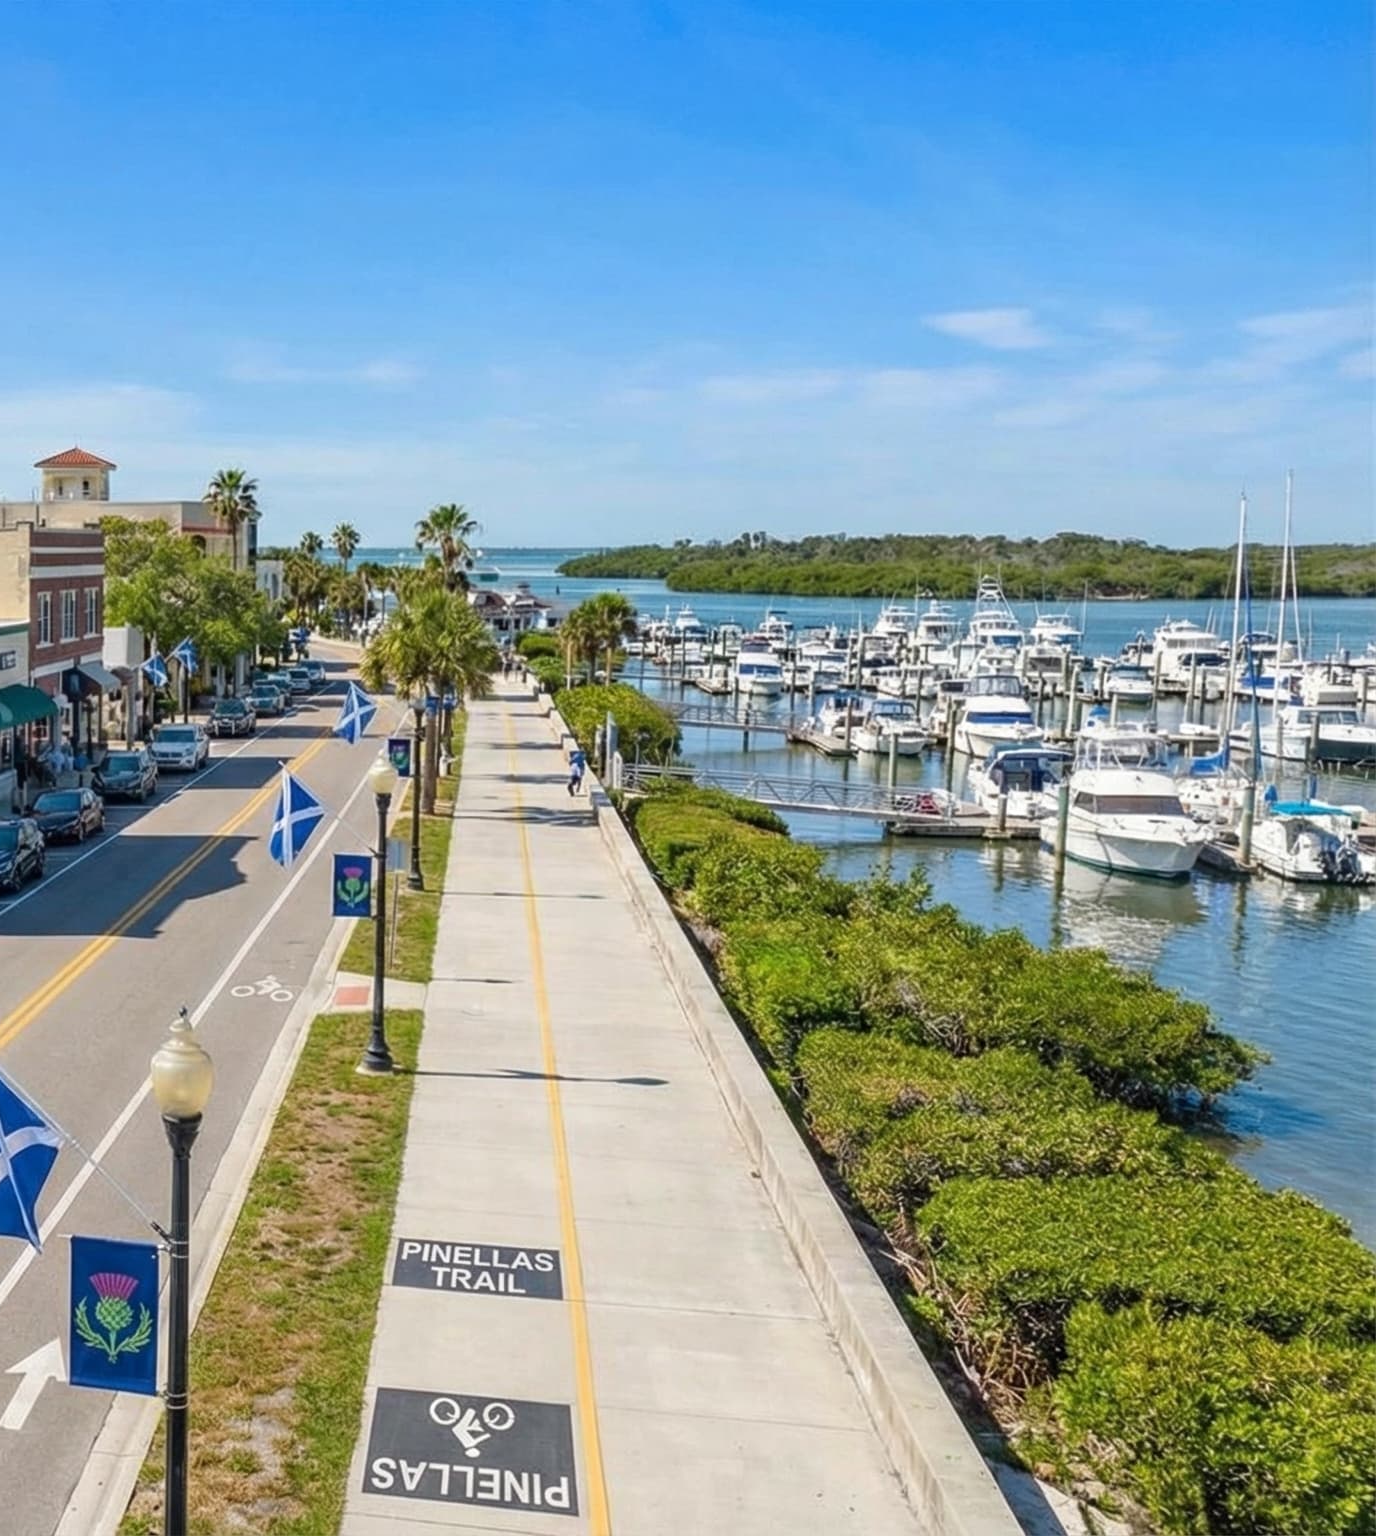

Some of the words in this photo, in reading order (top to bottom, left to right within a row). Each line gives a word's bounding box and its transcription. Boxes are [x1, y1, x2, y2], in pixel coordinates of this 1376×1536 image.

[401, 1242, 554, 1272] PINELLAS
[431, 1266, 526, 1294] TRAIL
[371, 1457, 571, 1509] PINELLAS
